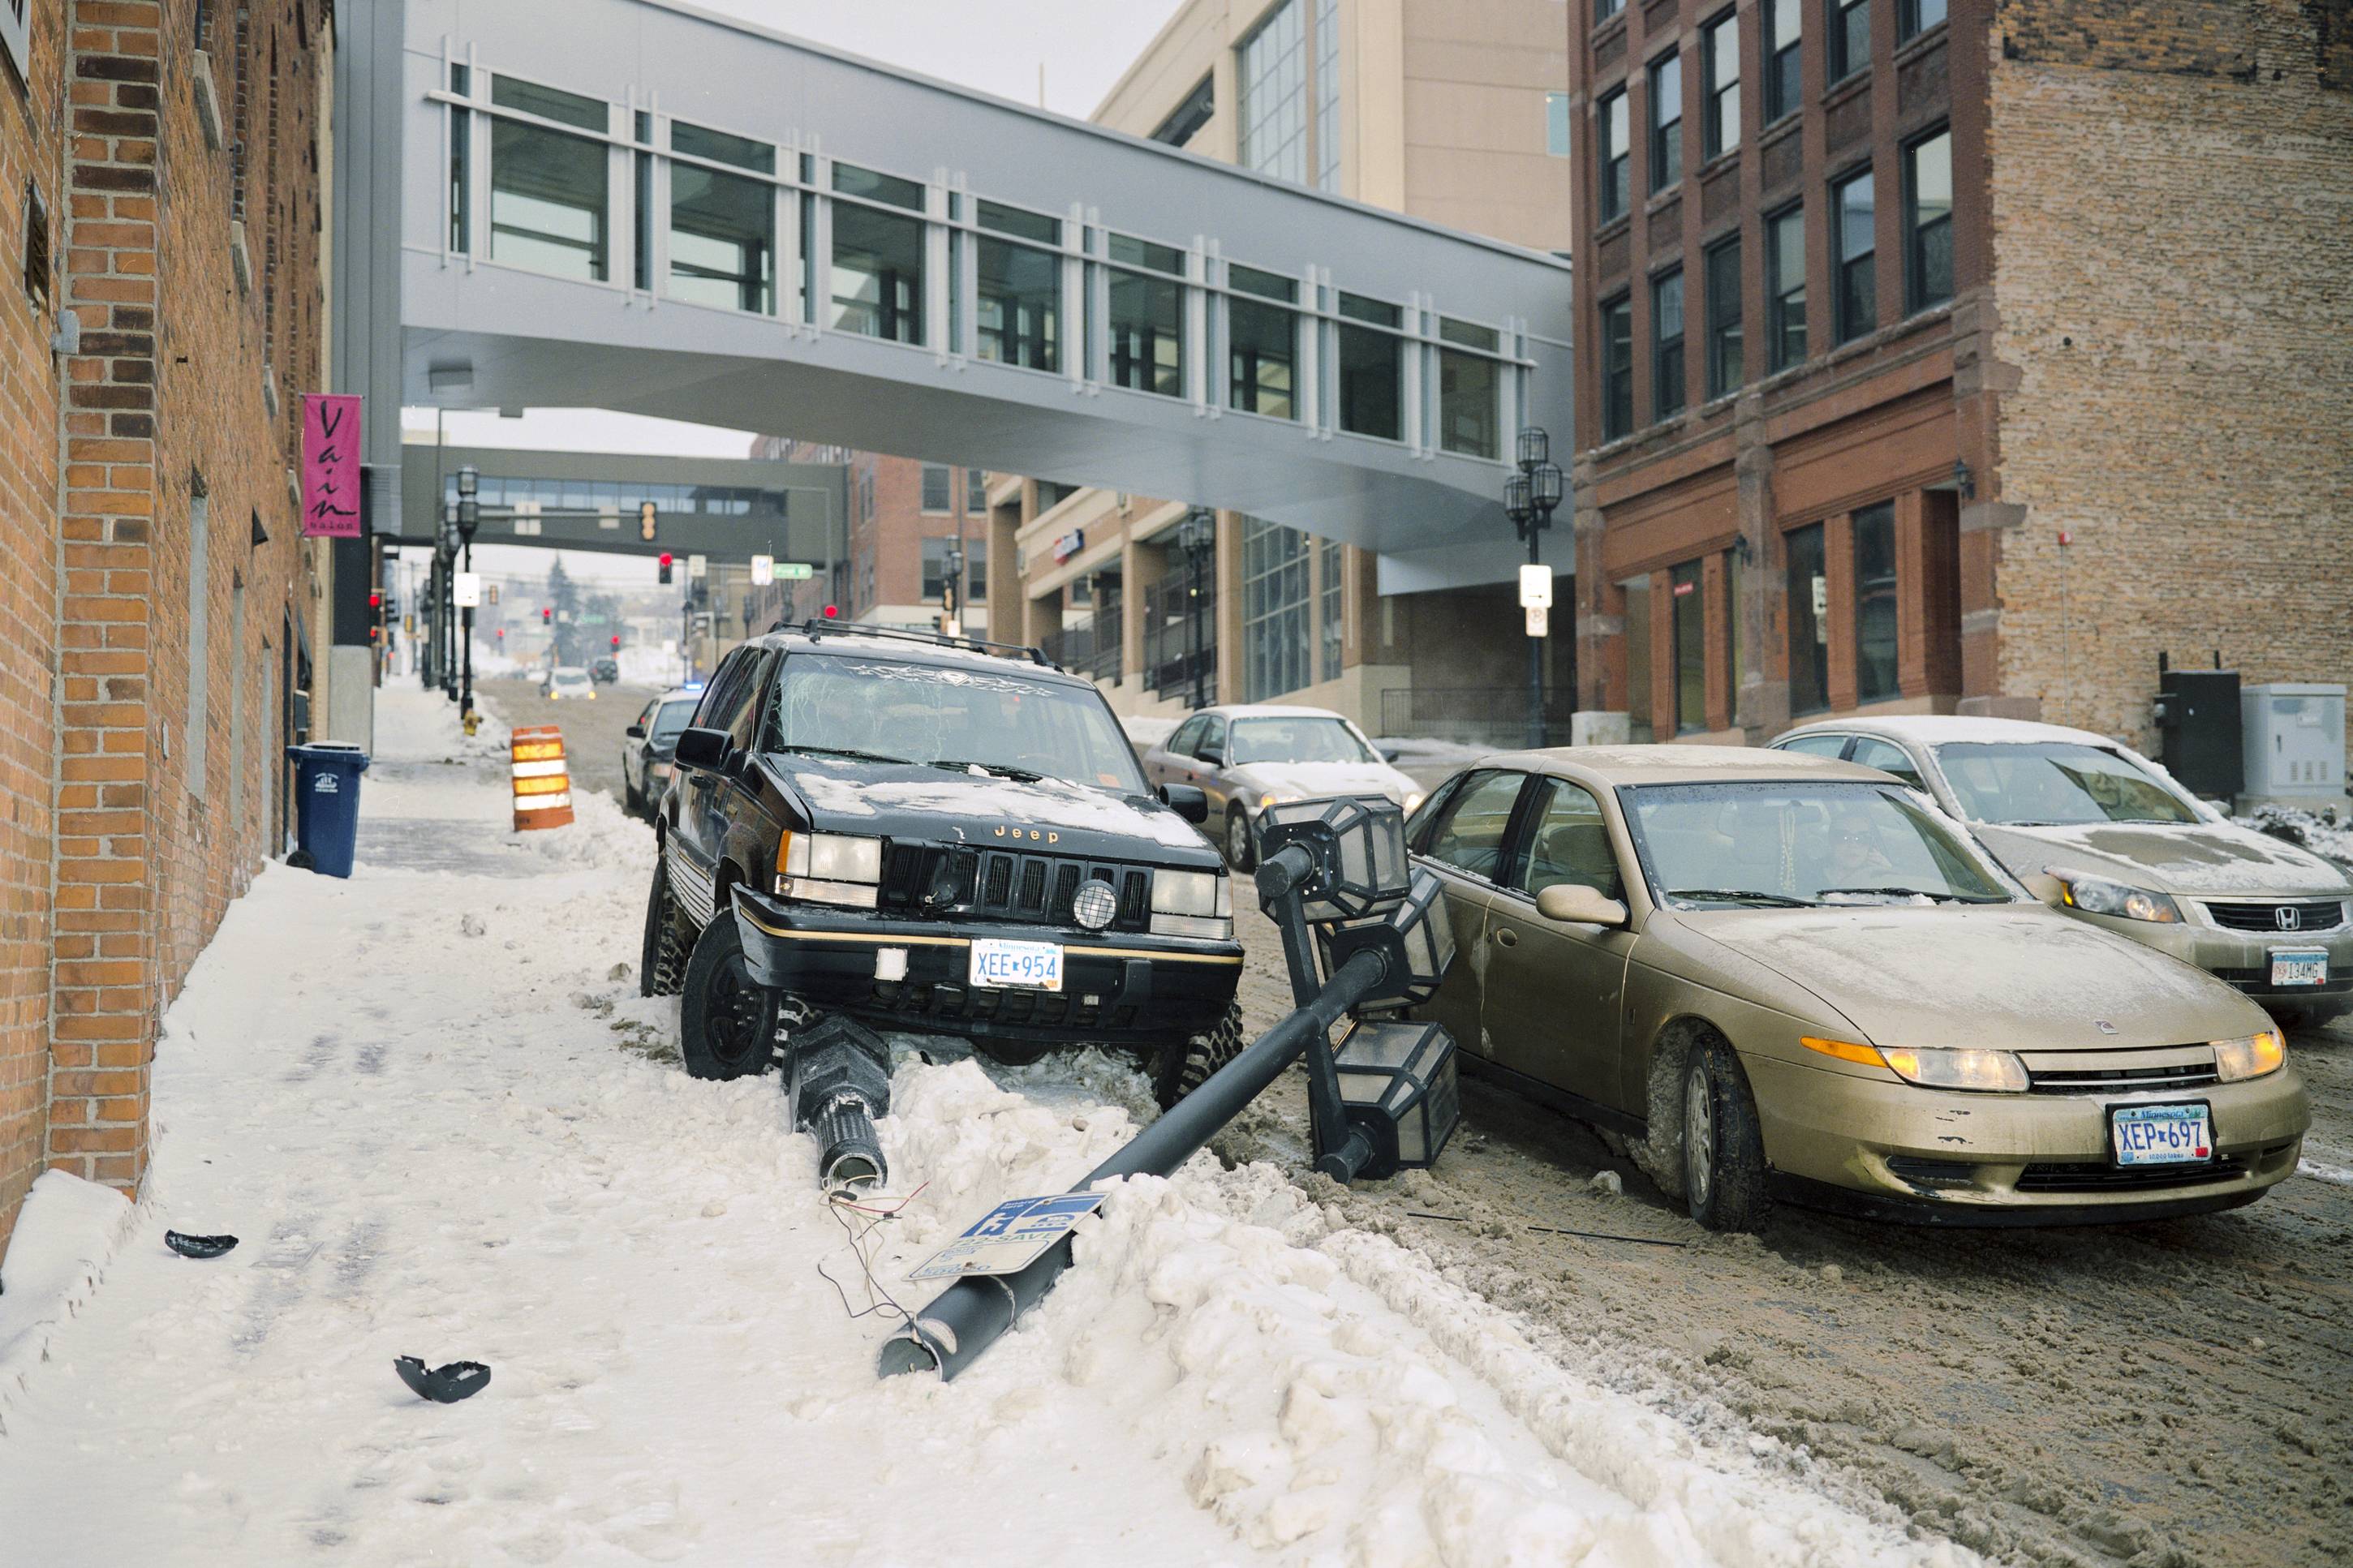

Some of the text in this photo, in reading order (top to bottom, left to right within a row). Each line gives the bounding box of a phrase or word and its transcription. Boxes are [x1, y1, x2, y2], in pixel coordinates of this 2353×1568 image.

[310, 401, 357, 518] Vain
[994, 825, 1059, 844] Jeep
[999, 942, 1040, 952] Minnesota
[2141, 1110, 2184, 1119] Minnesota
